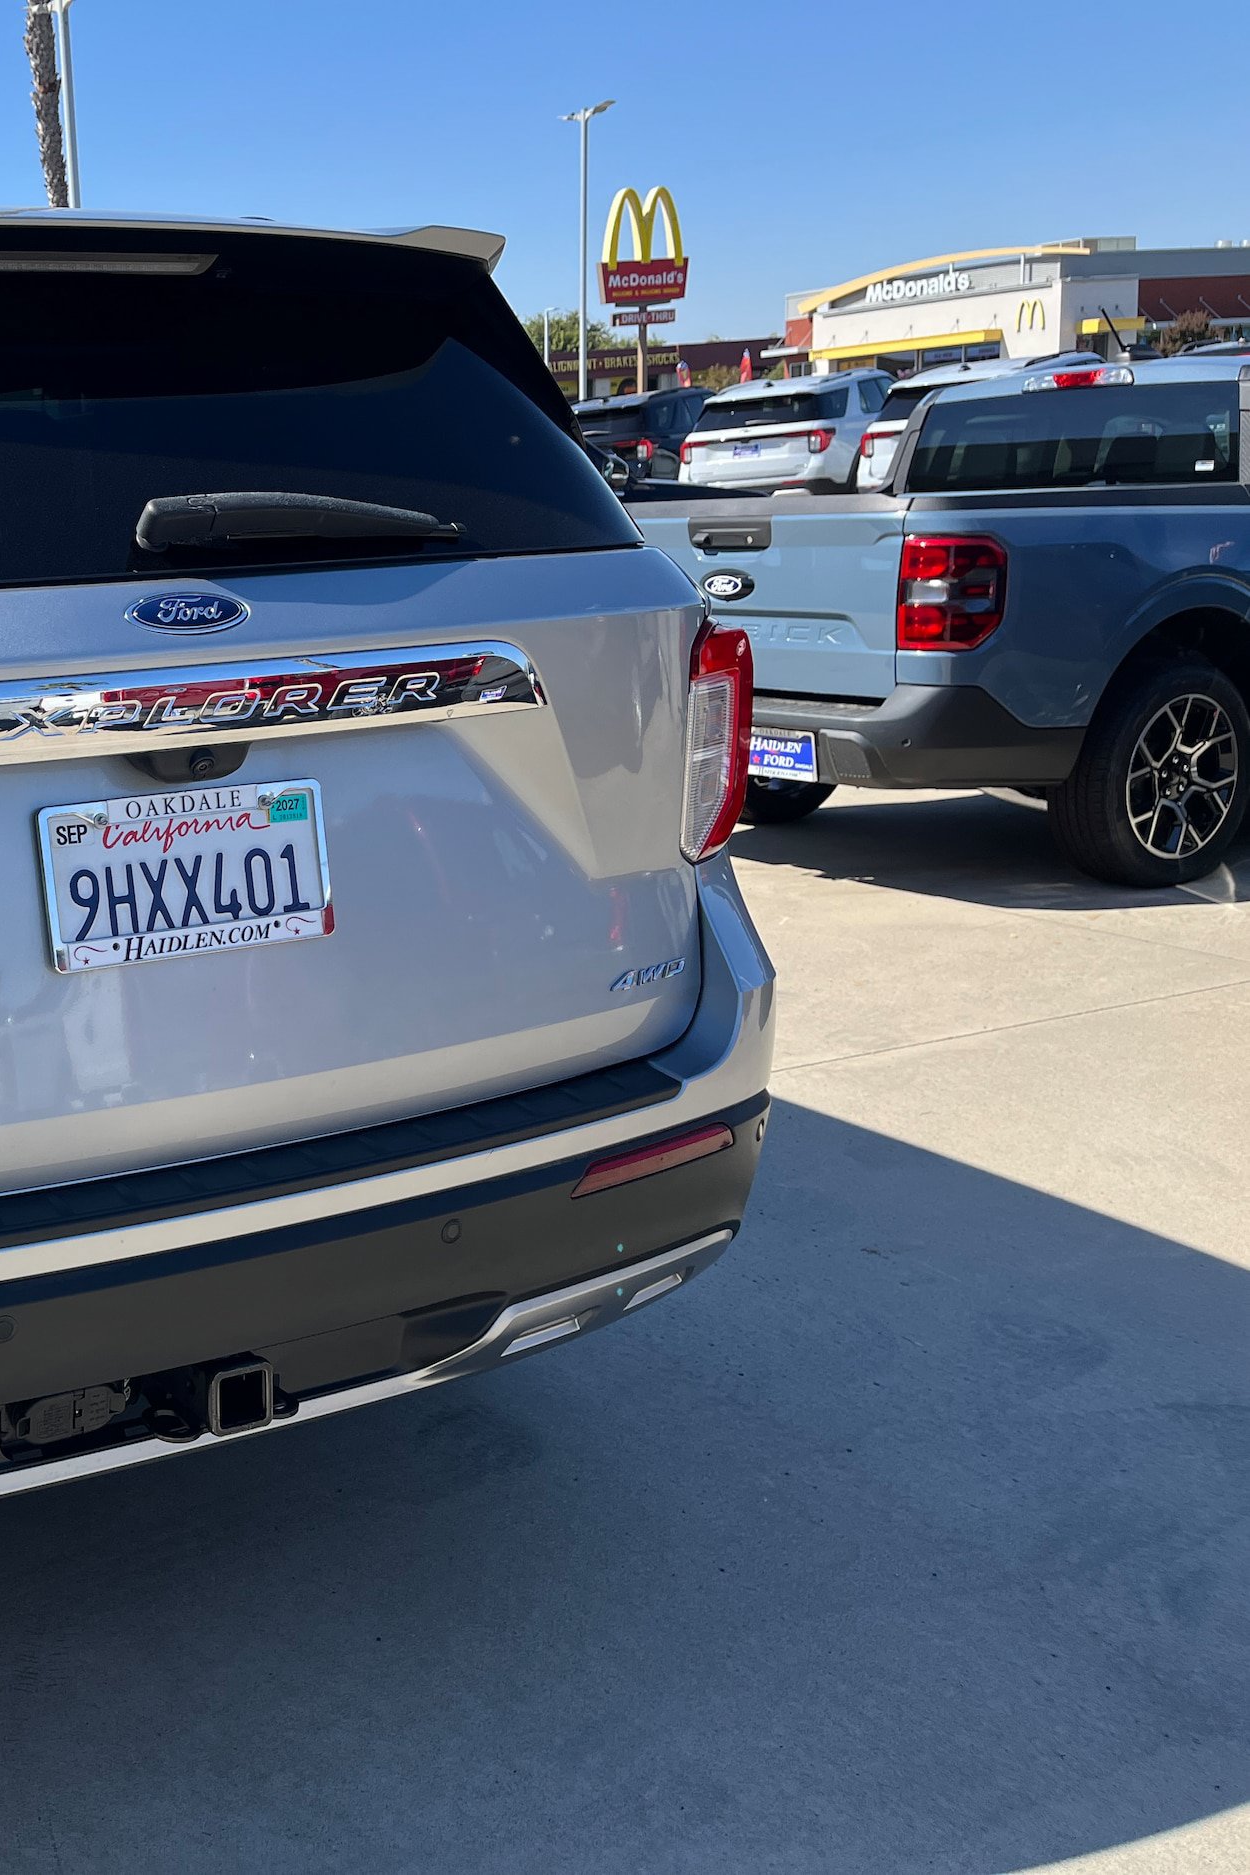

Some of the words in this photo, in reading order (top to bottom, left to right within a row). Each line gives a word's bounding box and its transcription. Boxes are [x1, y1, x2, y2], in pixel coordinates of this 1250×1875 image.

[608, 270, 684, 288] McDonald's
[865, 267, 970, 303] McDonald's
[157, 597, 223, 623] Ford
[721, 622, 843, 645] RICK
[750, 735, 803, 754] HAIDLEN
[763, 753, 795, 768] FORD
[126, 789, 242, 819] OAKDALE
[276, 798, 300, 812] 2027
[56, 823, 88, 846] SEP
[103, 811, 270, 853] California
[69, 843, 310, 941] 9HXX401
[123, 922, 271, 962] HAIDLEN.COM
